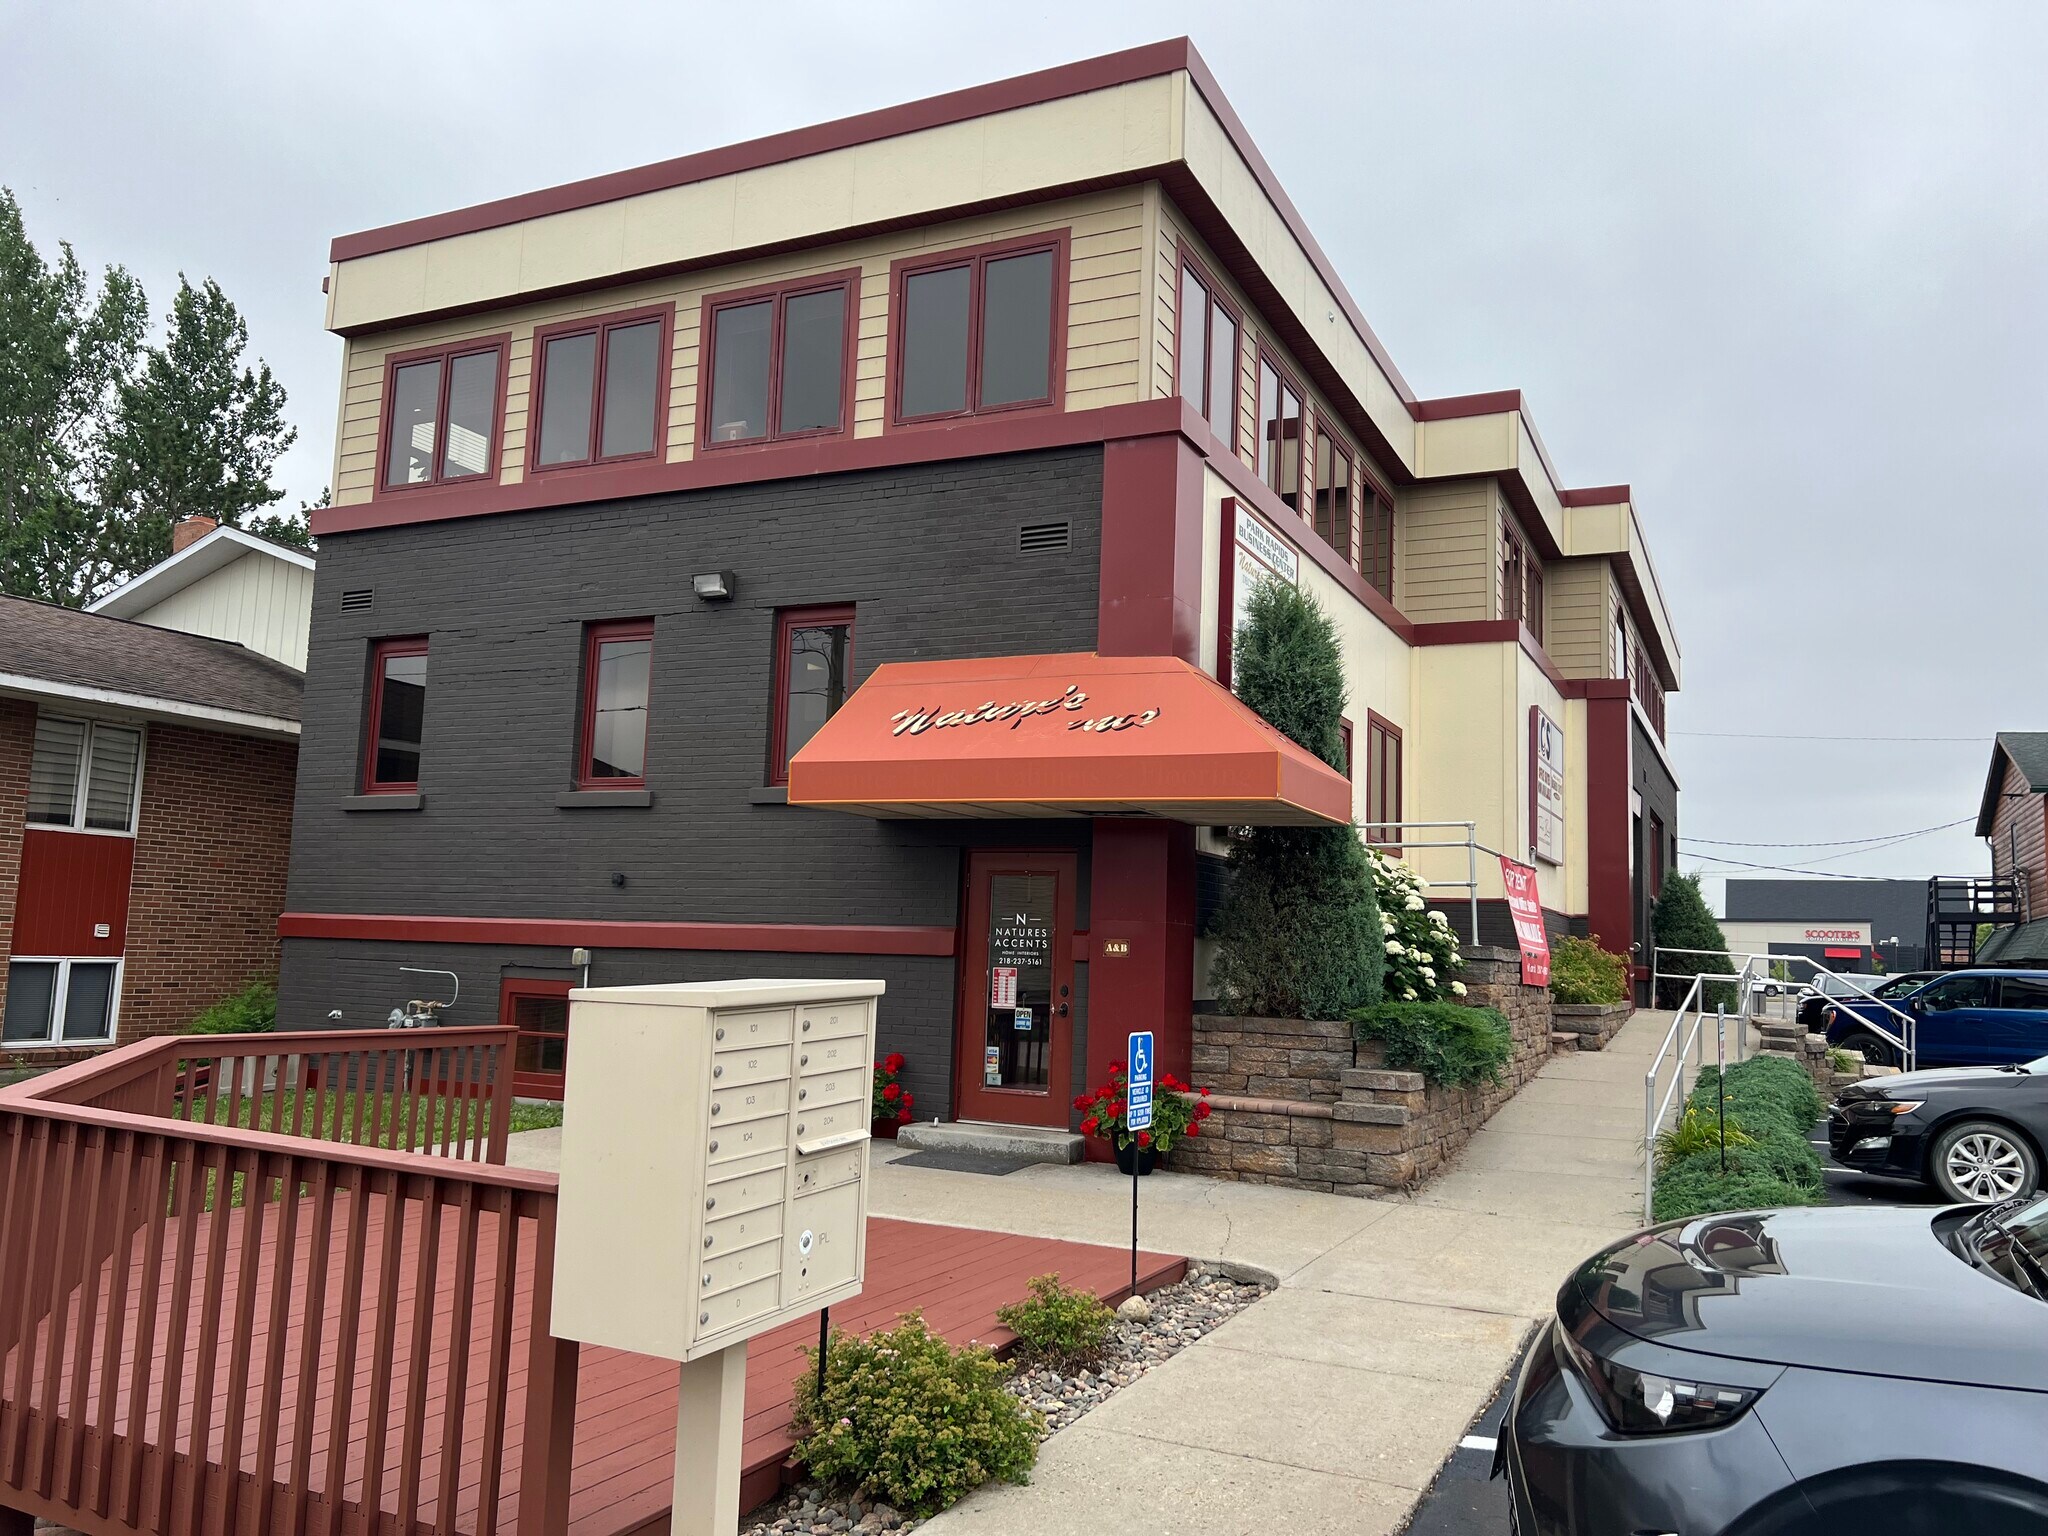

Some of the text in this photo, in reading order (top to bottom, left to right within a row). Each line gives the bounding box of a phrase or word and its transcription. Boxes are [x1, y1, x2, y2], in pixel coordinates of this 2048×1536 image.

[1246, 518, 1289, 562] PARK RAPIDS
[1239, 524, 1295, 579] BUSINESS CENTER
[1016, 913, 1026, 925] N
[995, 927, 1047, 937] NATURES
[1805, 930, 1860, 939] SCOOTER'S
[994, 939, 1048, 949] ACCENTS
[1106, 943, 1127, 952] A&B
[998, 957, 1042, 966] 218-237-5161
[1015, 1009, 1031, 1018] OPEN
[830, 1016, 839, 1025] 201
[750, 1023, 758, 1033] 101
[827, 1049, 837, 1058] 202
[748, 1059, 758, 1069] 102
[825, 1082, 835, 1091] 203
[746, 1095, 755, 1105] 103
[823, 1116, 833, 1126] 204
[743, 1132, 753, 1141] 104
